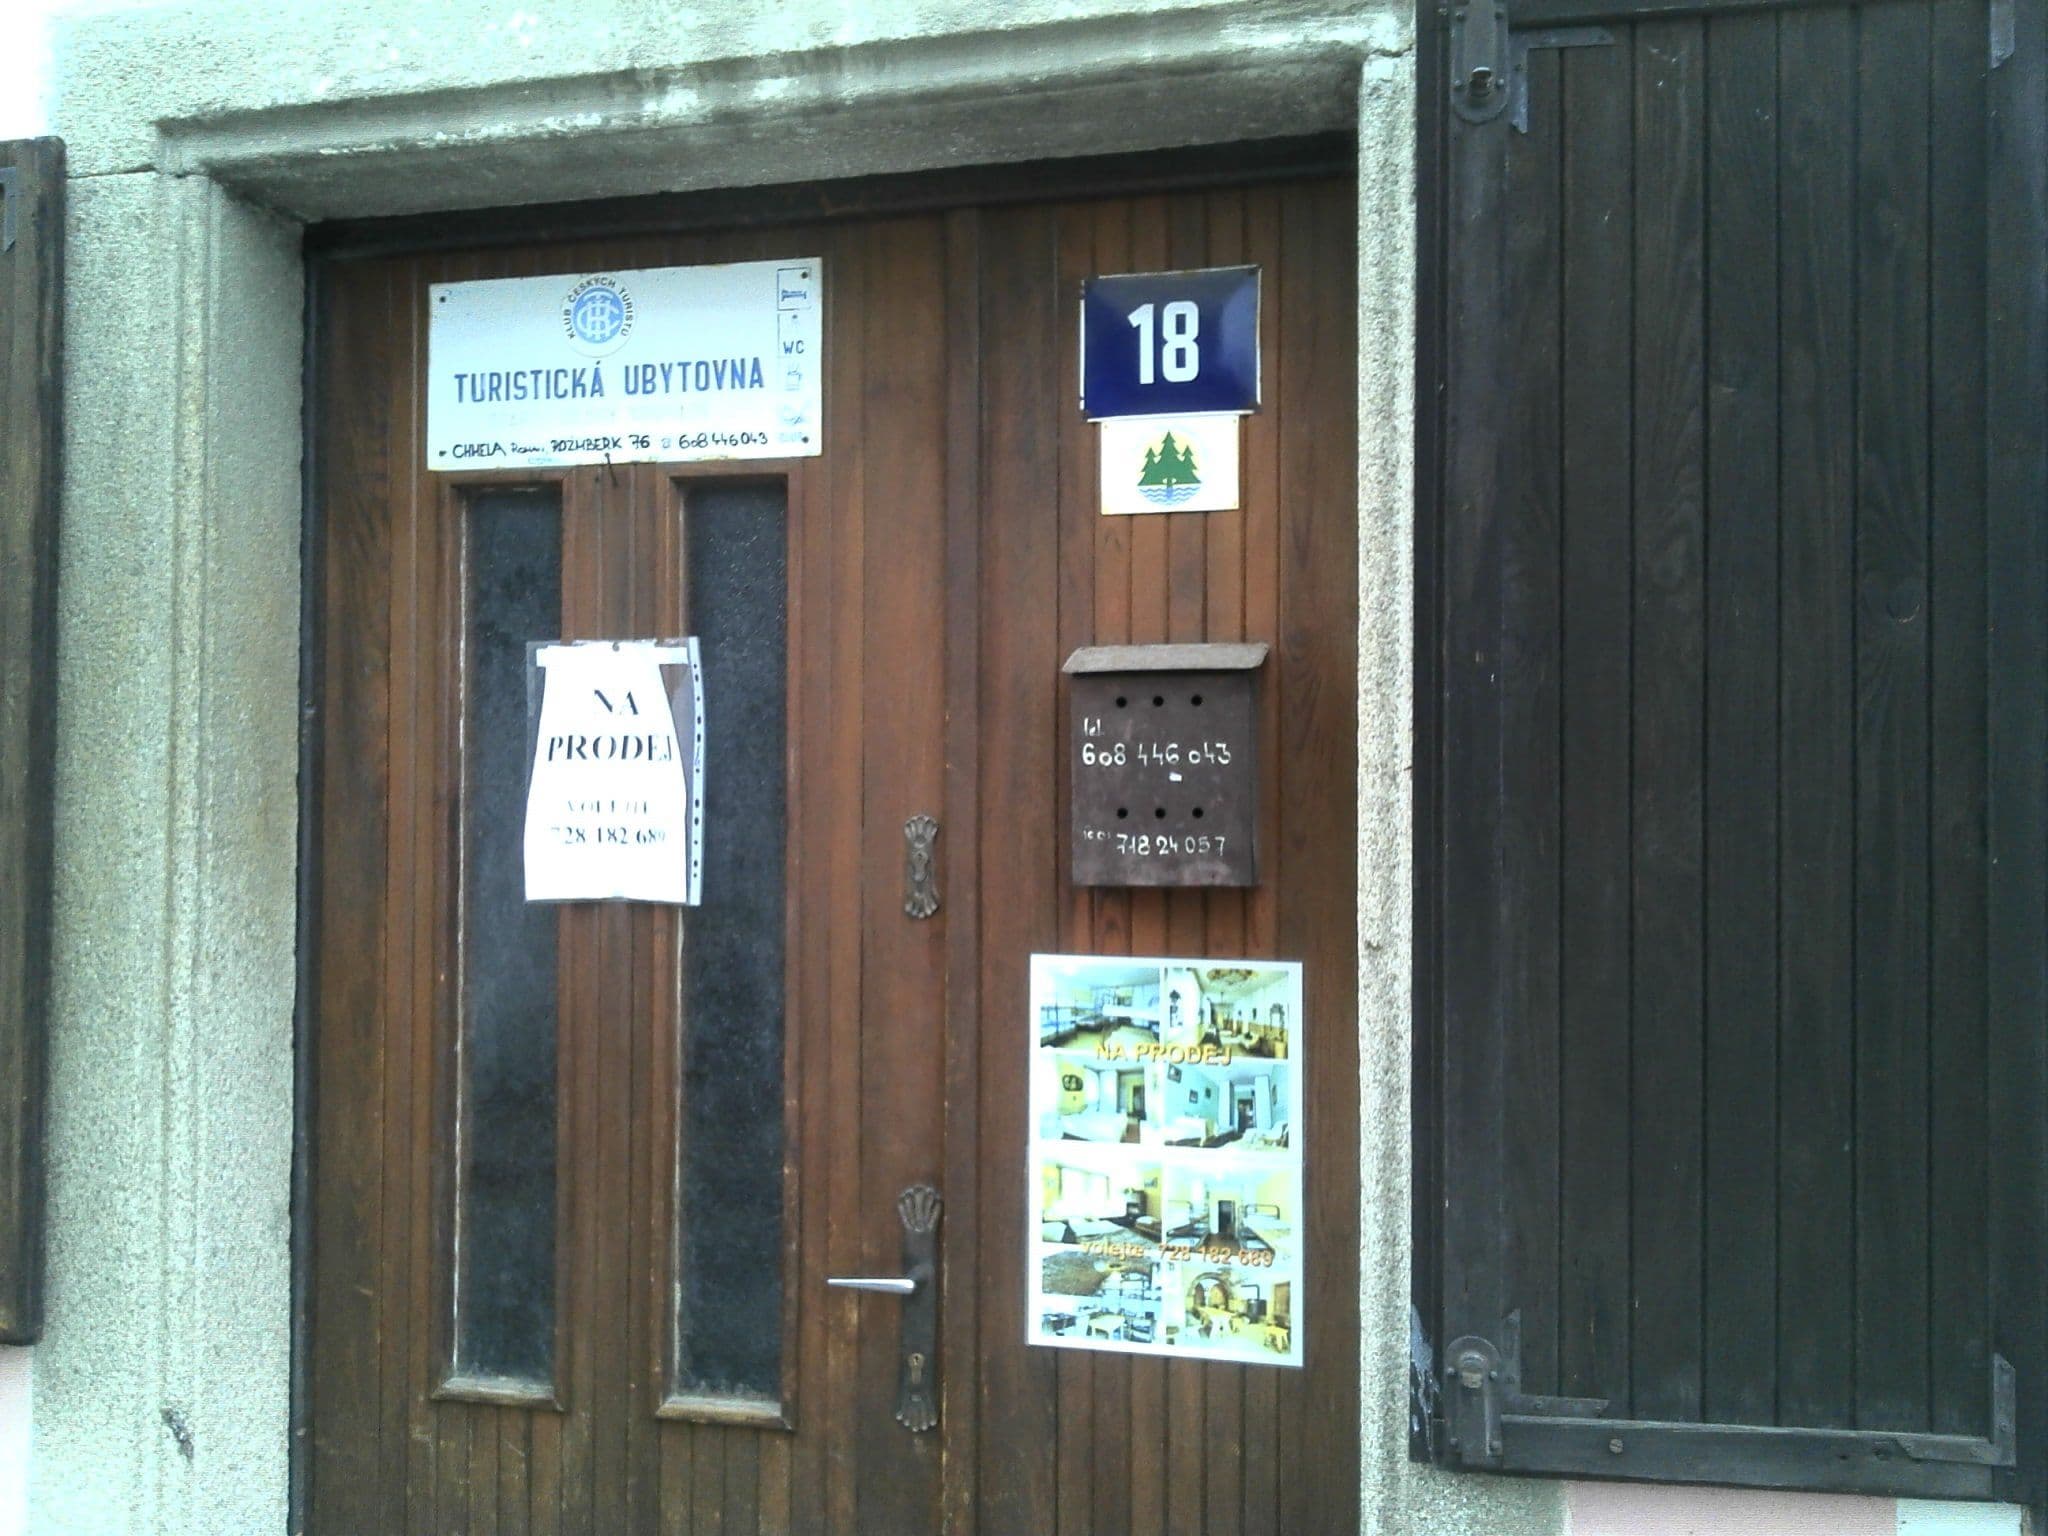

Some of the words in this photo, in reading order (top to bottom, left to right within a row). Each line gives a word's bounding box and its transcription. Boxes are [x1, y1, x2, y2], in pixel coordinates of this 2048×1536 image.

[783, 339, 805, 355] WC
[1127, 300, 1200, 385] 18
[454, 361, 605, 404] TURISTICKÁ
[624, 356, 765, 396] UBYTOVNA
[628, 434, 651, 450] 76
[593, 688, 639, 716] NA
[548, 734, 673, 762] PRODEJ
[1082, 742, 1127, 767] 608
[1137, 742, 1180, 767] 446
[1188, 741, 1232, 765] 043
[1095, 1039, 1129, 1062] NA
[1134, 1041, 1233, 1067] PRODEJ
[1159, 1243, 1192, 1262] 728
